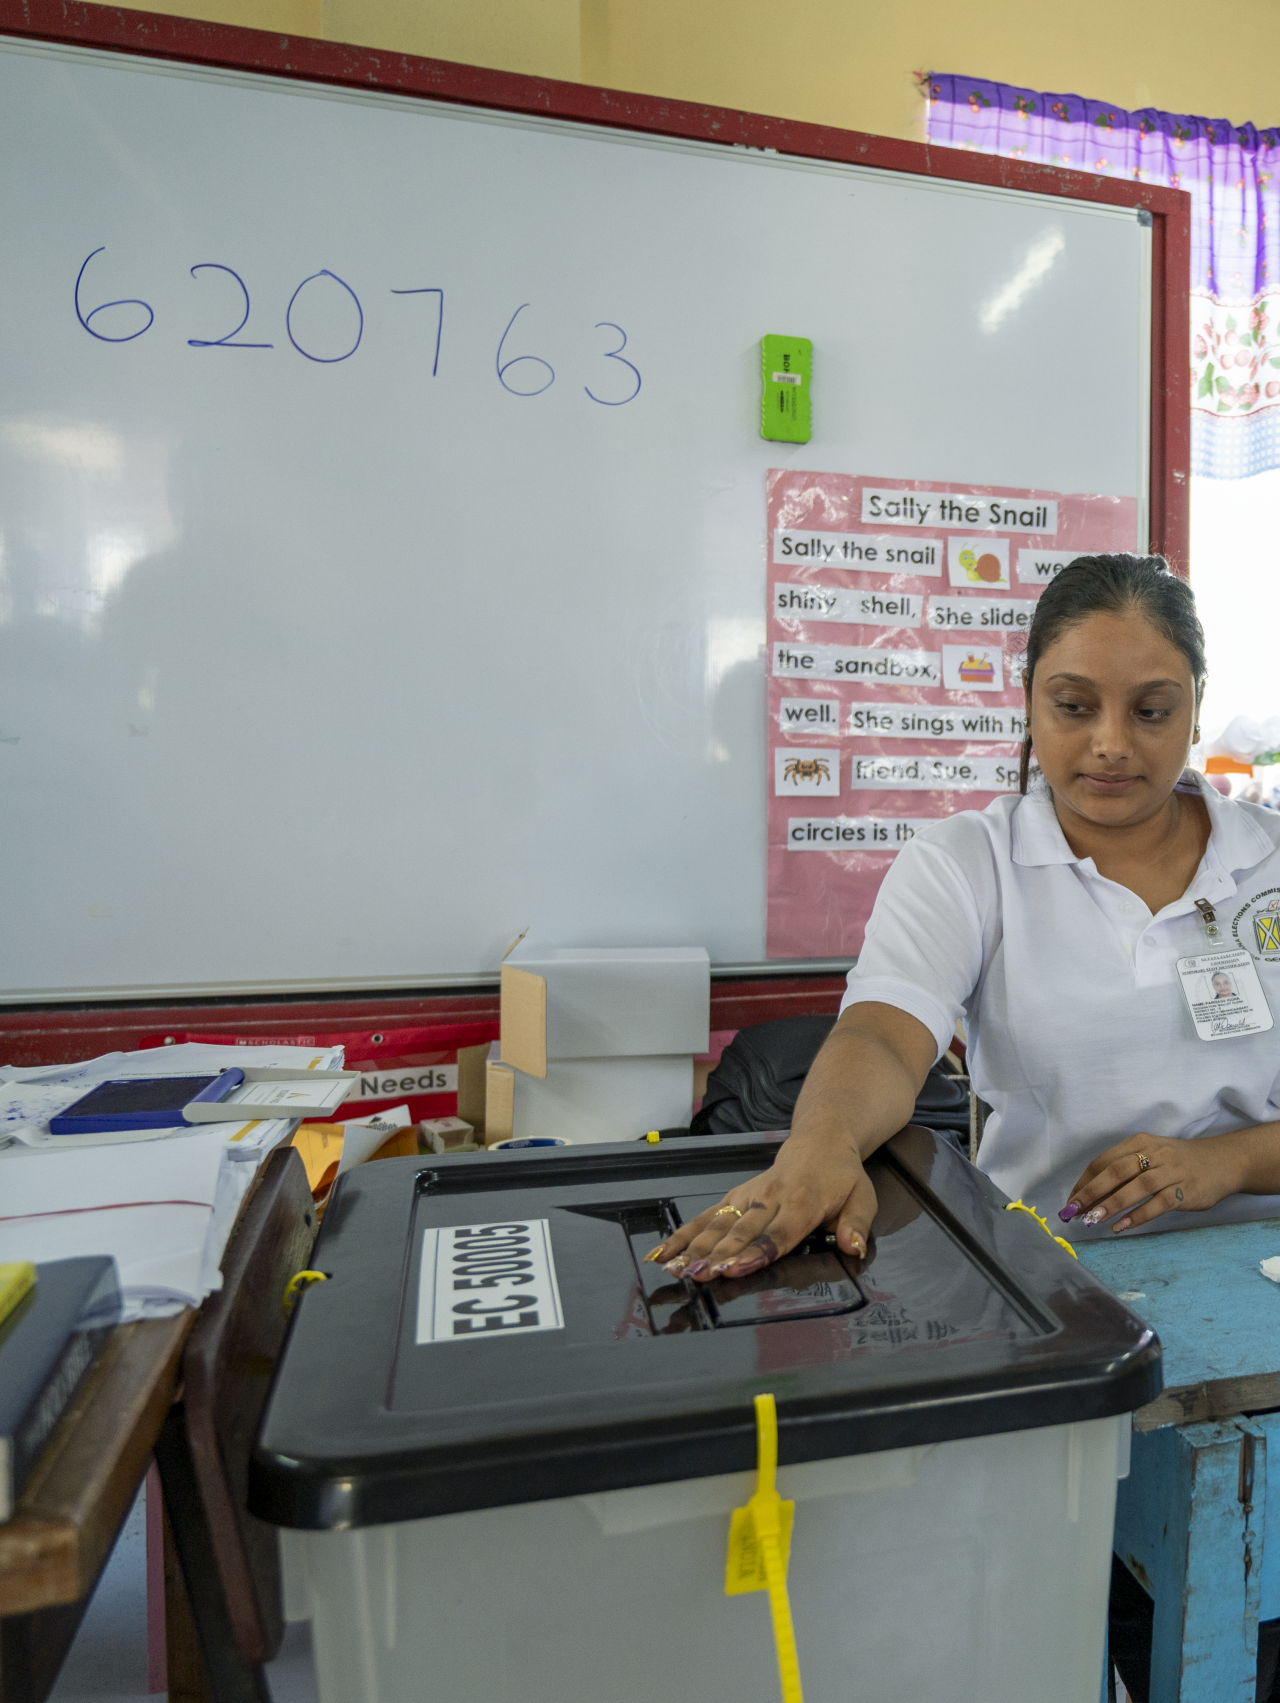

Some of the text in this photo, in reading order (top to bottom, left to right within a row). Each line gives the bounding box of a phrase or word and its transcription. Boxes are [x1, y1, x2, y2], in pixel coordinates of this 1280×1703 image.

[869, 495, 1047, 528] Sally the Snail
[781, 537, 836, 562] Sally
[842, 540, 878, 562] the
[886, 543, 936, 565] snail
[778, 591, 837, 614] shiny
[935, 607, 973, 625] She
[778, 648, 938, 680] the sandbox,
[785, 704, 837, 723] well.
[854, 711, 893, 730] She
[901, 712, 954, 735] sings
[962, 715, 1003, 733] with
[791, 822, 866, 842] circles
[873, 823, 888, 841] is
[1231, 903, 1251, 938] ELECTIONS
[361, 1070, 447, 1096] Needs
[452, 1224, 540, 1335] EC 50005
